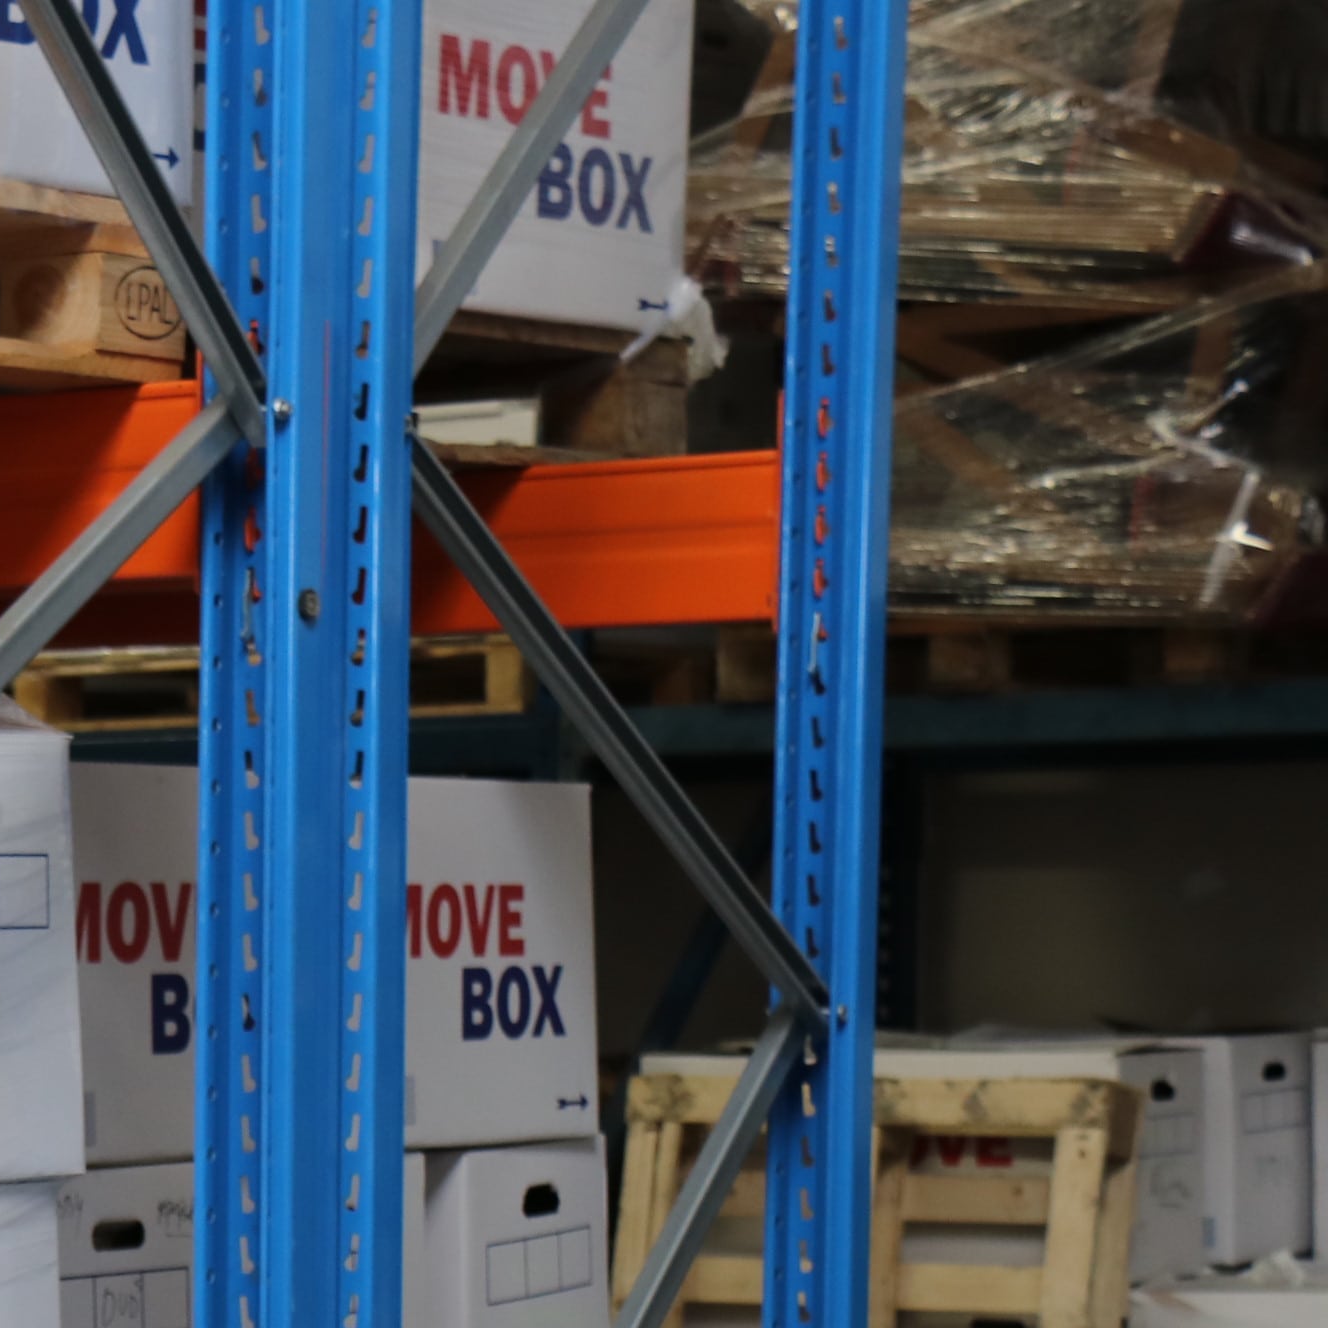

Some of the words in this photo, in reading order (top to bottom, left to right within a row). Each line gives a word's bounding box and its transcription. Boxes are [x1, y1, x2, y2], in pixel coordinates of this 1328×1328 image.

[439, 34, 611, 140] MOE
[538, 143, 653, 233] BOX
[461, 964, 566, 1042] BOX
